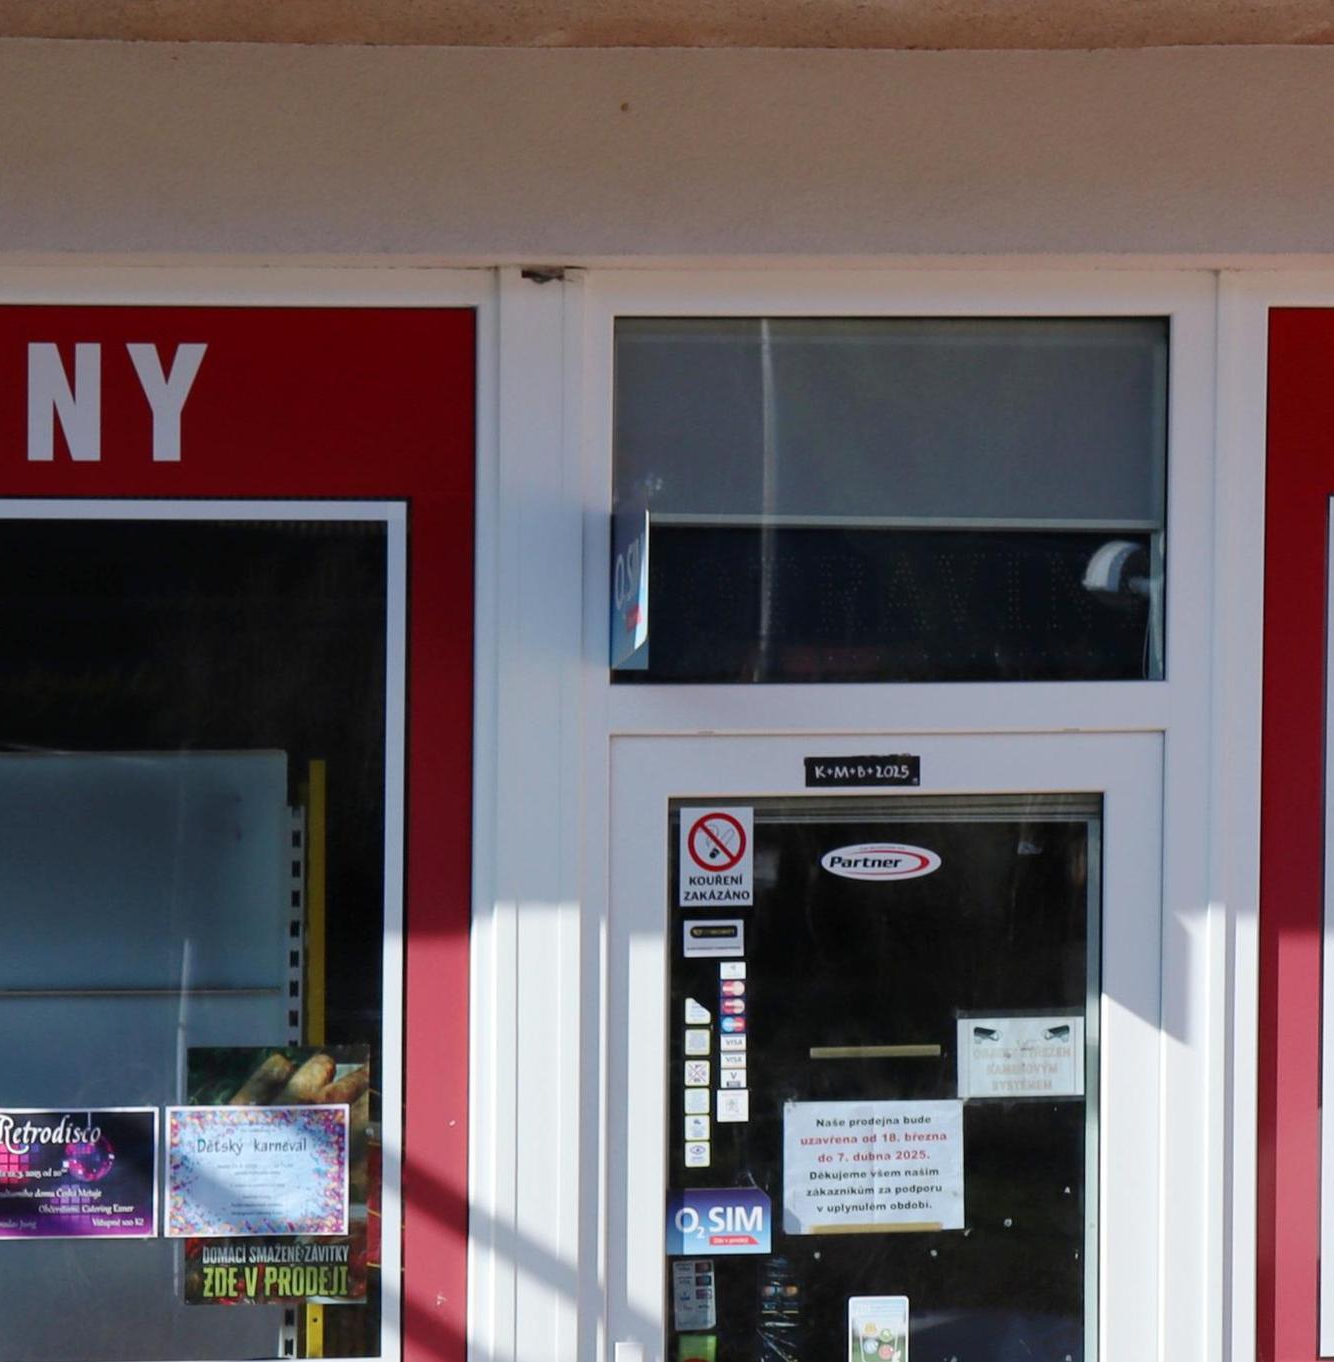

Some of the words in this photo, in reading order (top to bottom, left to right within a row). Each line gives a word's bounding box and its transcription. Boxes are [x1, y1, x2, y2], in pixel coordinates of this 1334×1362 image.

[829, 856, 902, 868] Partner
[688, 874, 743, 886] KOUŘENÍ
[684, 889, 750, 901] ZAKÁZÁNO
[816, 1118, 845, 1128] Naše
[849, 1116, 900, 1128] prodejna
[903, 1115, 931, 1125] bude
[800, 1135, 858, 1146] uzavřena
[862, 1134, 877, 1143] od
[882, 1133, 900, 1143] 18.
[905, 1132, 947, 1142] března
[197, 1138, 243, 1155] Dětský
[254, 1138, 307, 1151] karneval
[818, 1153, 833, 1163] do
[838, 1153, 849, 1162] 7.
[853, 1151, 891, 1162] dubna
[895, 1150, 930, 1160] 2025.
[809, 1170, 867, 1182] Děkujeme
[870, 1168, 901, 1178] všem
[806, 1185, 875, 1197] zákazníkům
[878, 1186, 892, 1195] za
[895, 1185, 942, 1196] podporu
[827, 1202, 886, 1214] uplynulém
[890, 1201, 932, 1210] období.
[708, 1206, 763, 1233] SIM
[304, 1243, 349, 1263] ZÁVITKY
[203, 1266, 238, 1297] ZDE
[244, 1267, 258, 1297] V
[264, 1266, 348, 1297] PRODEJI
